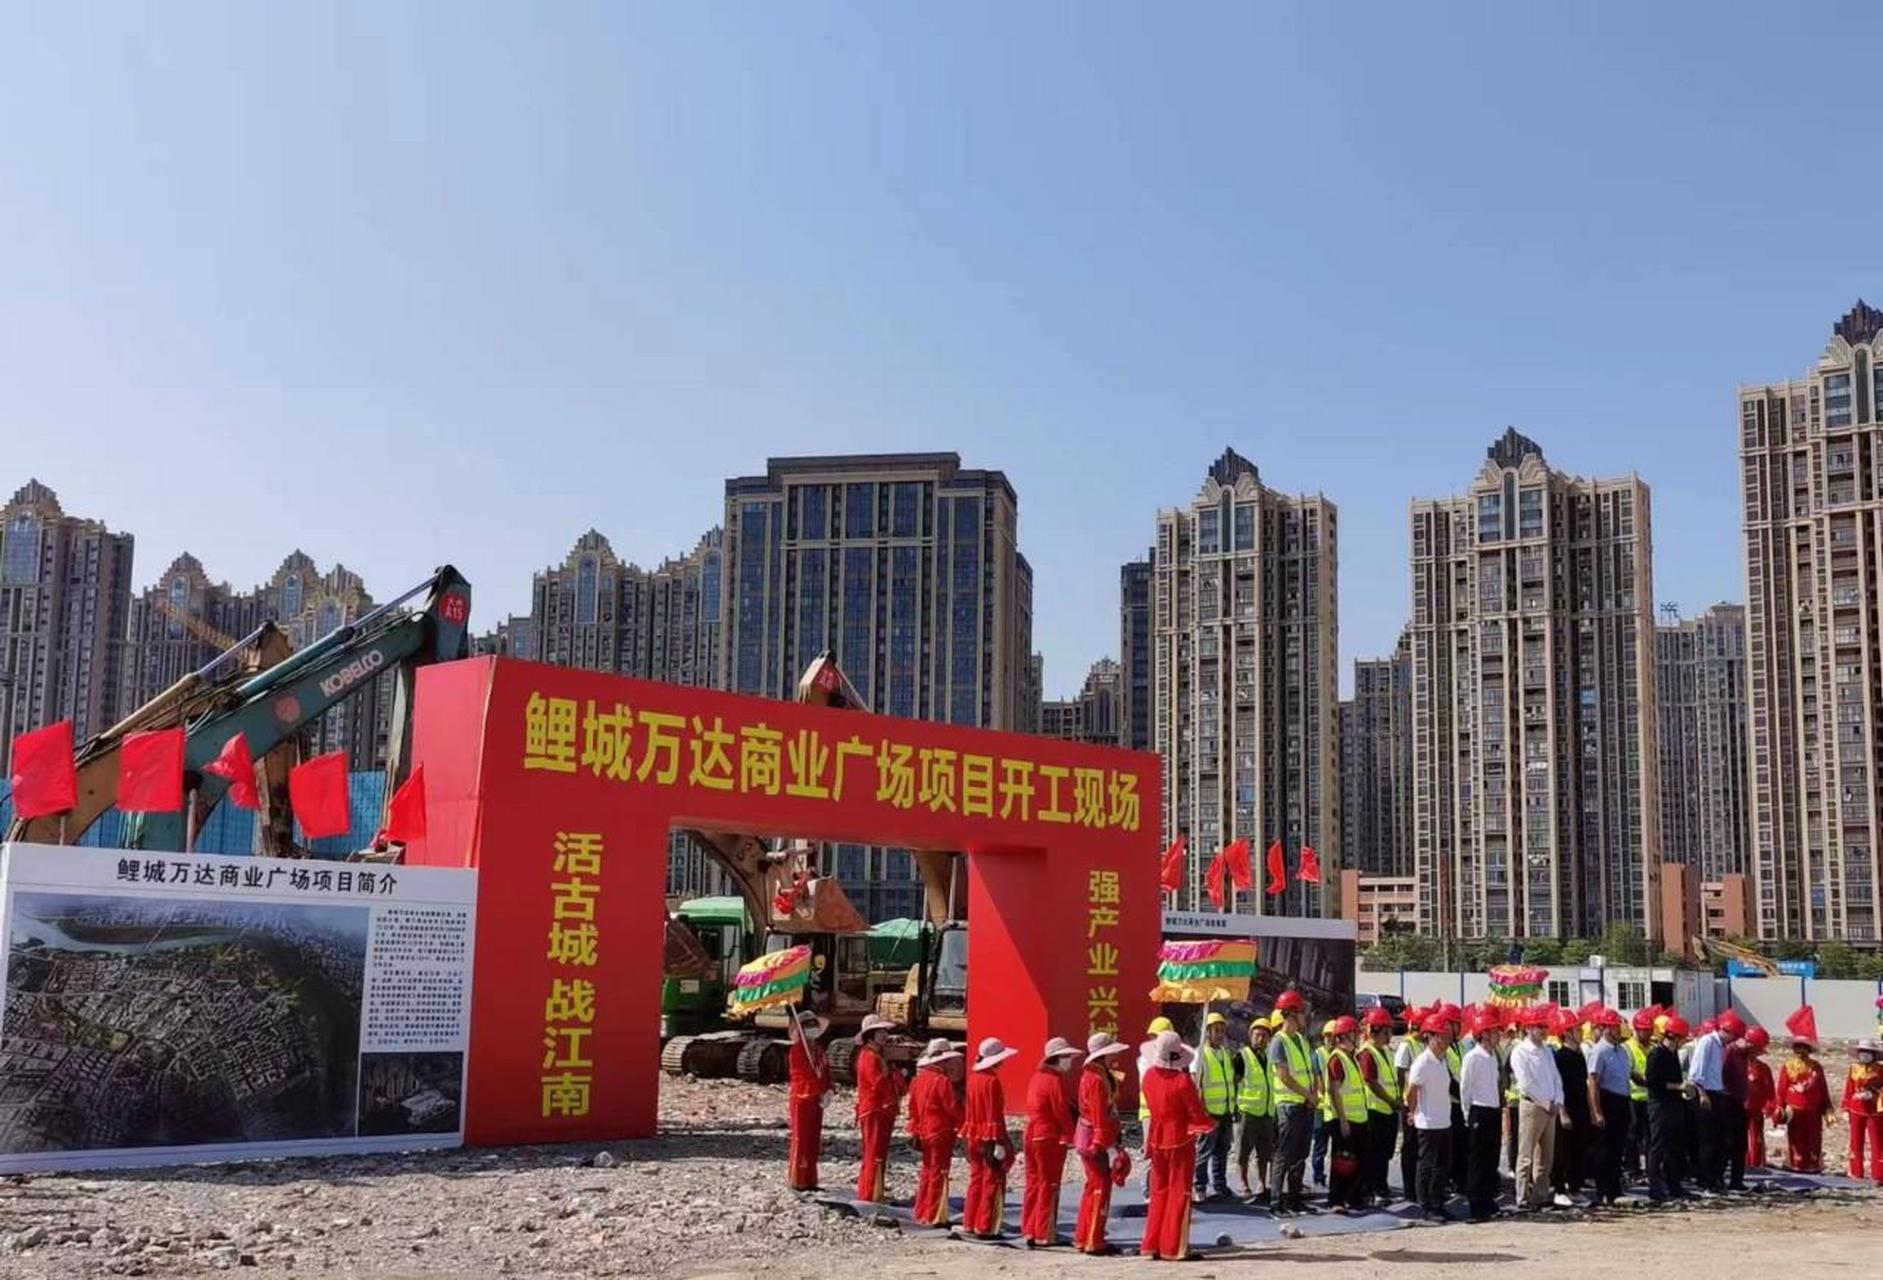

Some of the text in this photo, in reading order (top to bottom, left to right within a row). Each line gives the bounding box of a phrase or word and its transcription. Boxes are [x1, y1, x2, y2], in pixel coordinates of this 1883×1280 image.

[320, 650, 384, 697] KOBELCO
[524, 691, 1140, 831] 鲤城万达商业广场项目开工现场
[117, 858, 398, 895] 鲤城万达商业广场项目简介
